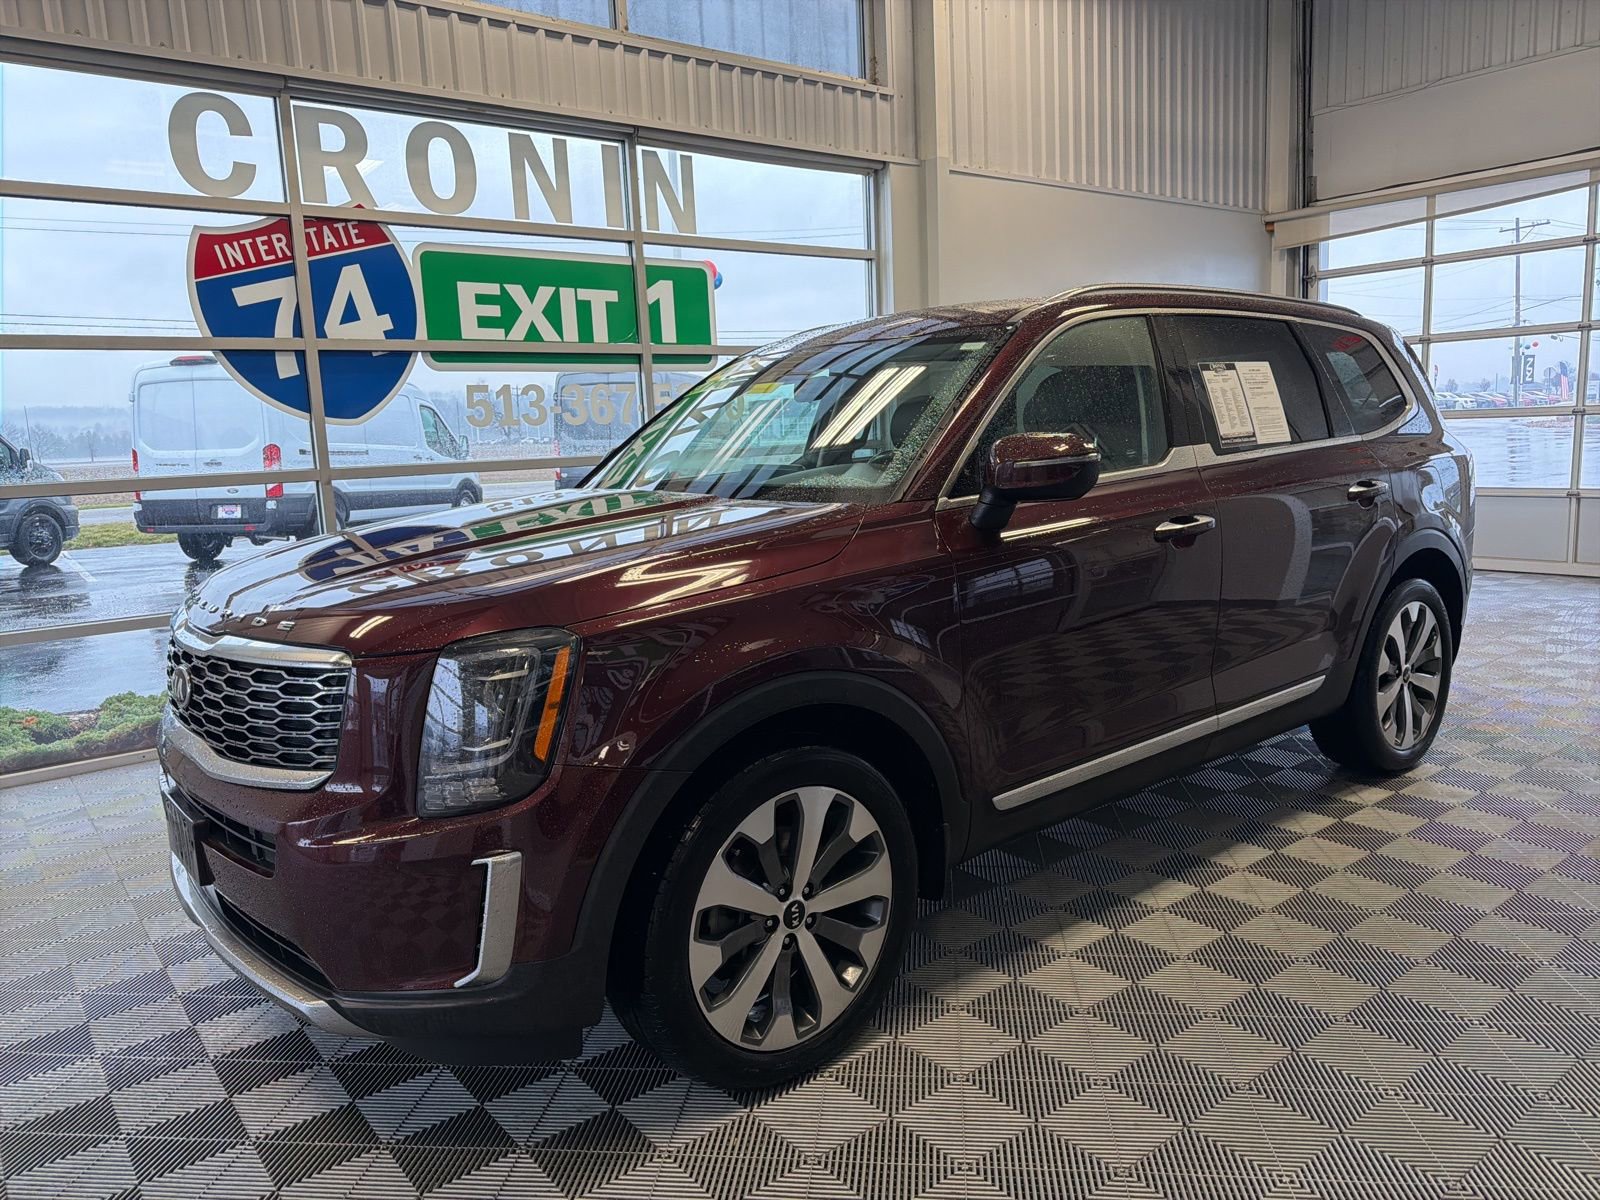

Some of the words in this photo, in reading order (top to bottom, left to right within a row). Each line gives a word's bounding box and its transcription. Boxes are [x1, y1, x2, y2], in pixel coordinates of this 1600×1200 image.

[168, 91, 697, 234] CRONIN
[214, 221, 365, 269] INTERTATE
[231, 263, 394, 380] 74
[457, 281, 619, 343] EXIT
[647, 280, 677, 343] 1
[791, 903, 800, 927] KIA
